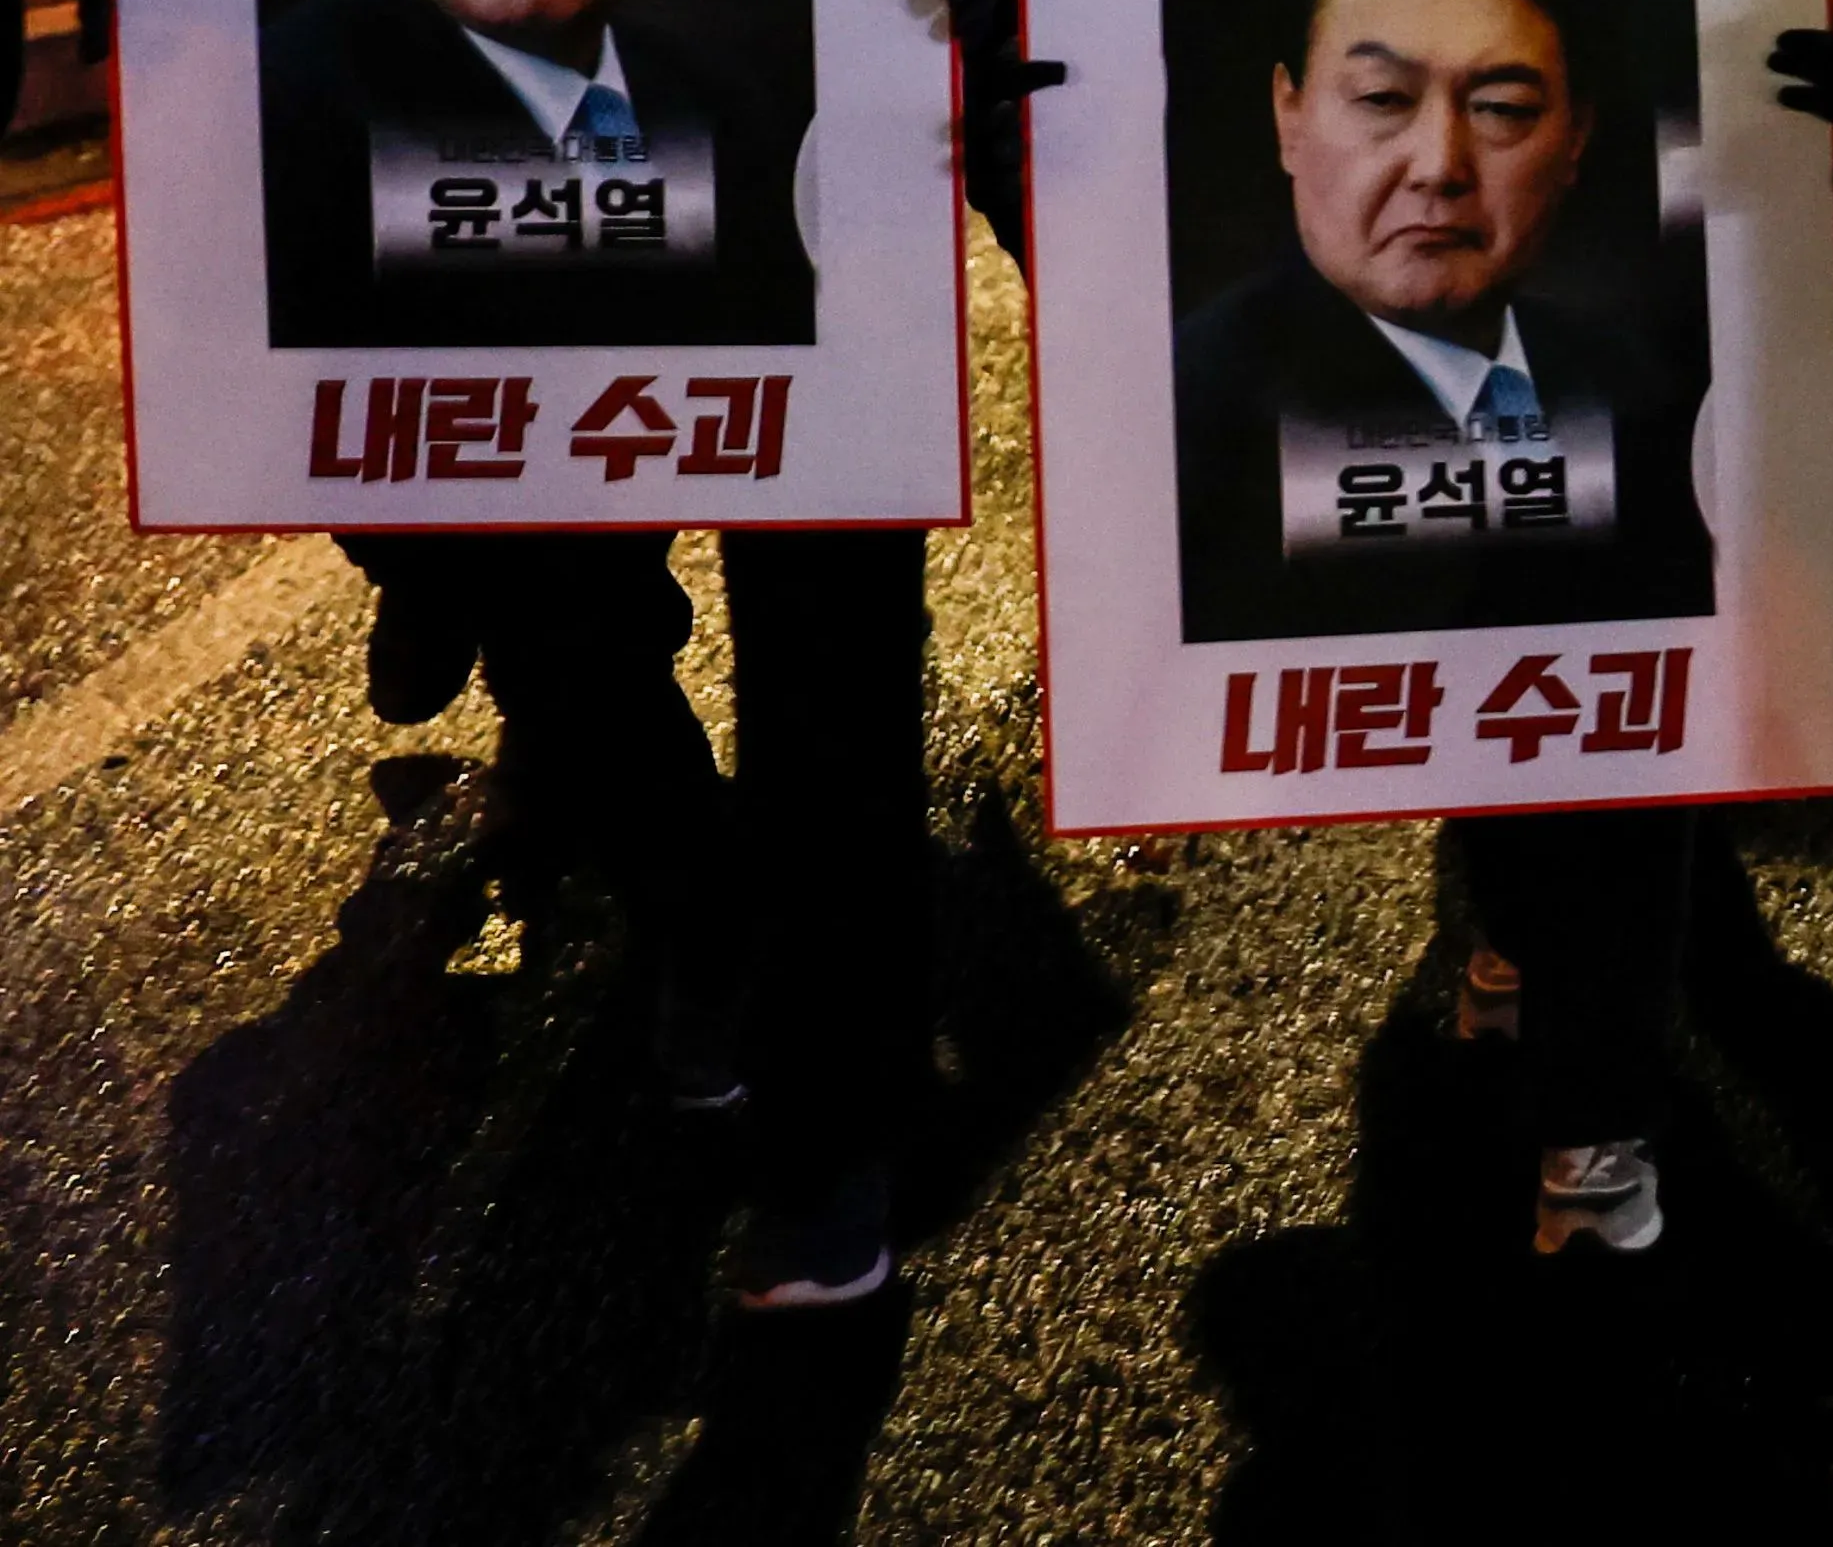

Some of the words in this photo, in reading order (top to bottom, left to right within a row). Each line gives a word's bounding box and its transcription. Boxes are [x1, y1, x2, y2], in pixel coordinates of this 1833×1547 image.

[427, 176, 668, 250] 윤석열
[308, 377, 540, 484] 내란
[569, 375, 793, 483] 수괴
[1336, 454, 1573, 538] 윤석열
[1220, 660, 1445, 776] 내란
[1475, 647, 1694, 765] 수괴
